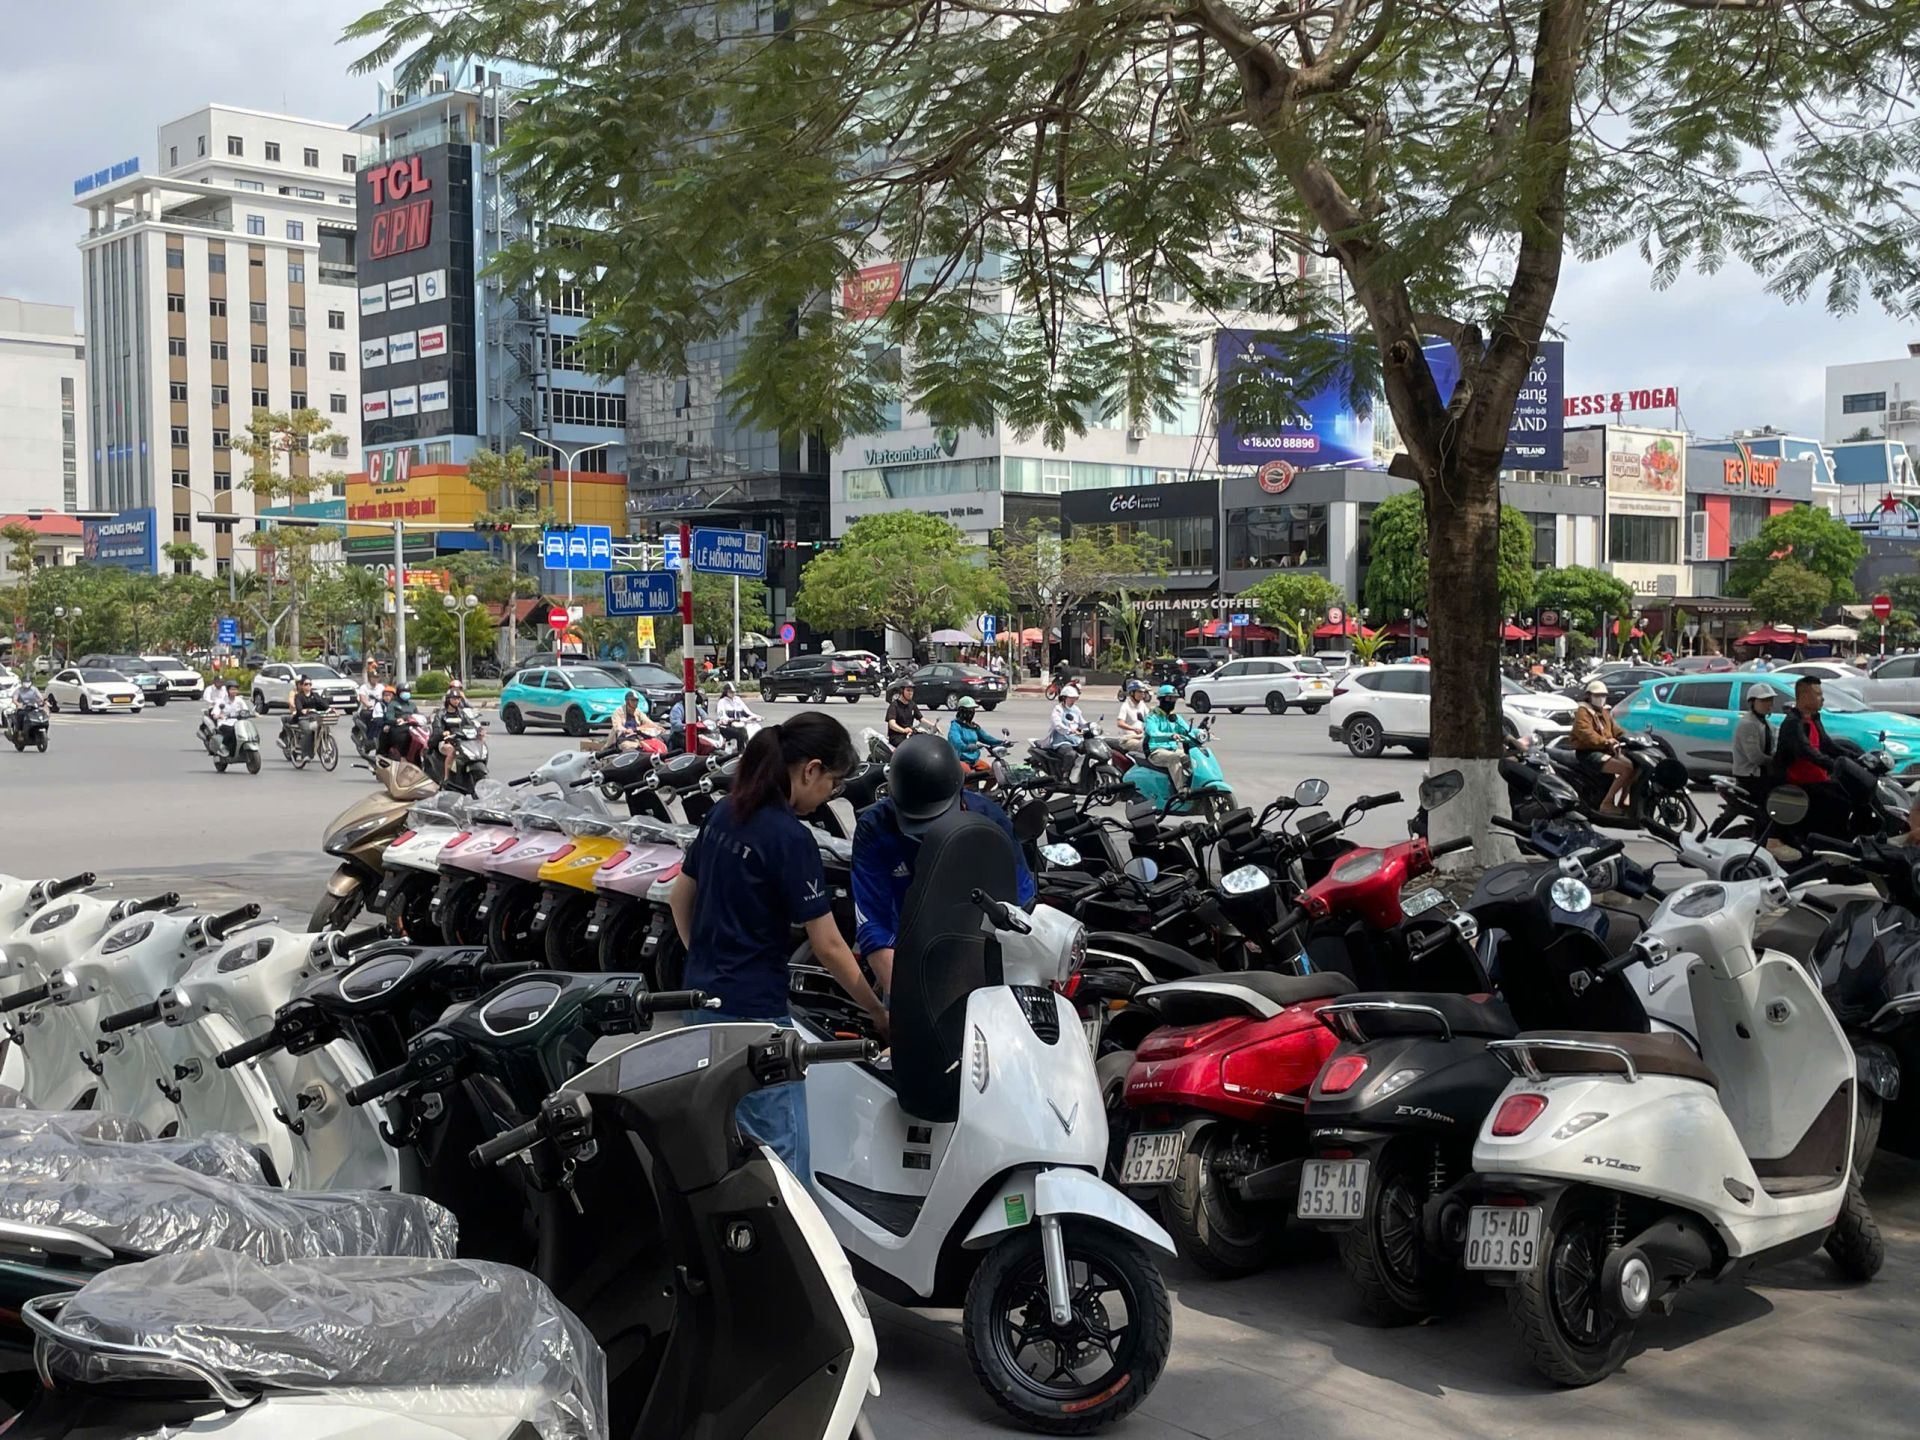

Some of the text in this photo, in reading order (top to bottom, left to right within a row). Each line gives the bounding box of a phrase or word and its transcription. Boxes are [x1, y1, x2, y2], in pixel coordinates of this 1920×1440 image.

[367, 155, 430, 205] TCL
[369, 199, 431, 259] CPN
[1610, 393, 1623, 412] &
[1629, 387, 1677, 409] YOGA
[864, 441, 942, 466] Vietcombank
[369, 450, 410, 483] CPN
[1724, 459, 1745, 484] 123
[697, 546, 762, 571] LÊ HỒNG PHONG
[633, 575, 650, 588] PHỐ
[649, 587, 669, 610] MẬU
[1132, 597, 1261, 611] HIGHLANDS COFFEE
[1132, 1135, 1177, 1158] 15-MD1
[1124, 1159, 1175, 1181] 497.52
[1314, 1164, 1356, 1188] 15-AA
[1302, 1190, 1361, 1214] 353.18
[1481, 1211, 1530, 1237] 15-AD
[1469, 1240, 1533, 1265] 003.69
